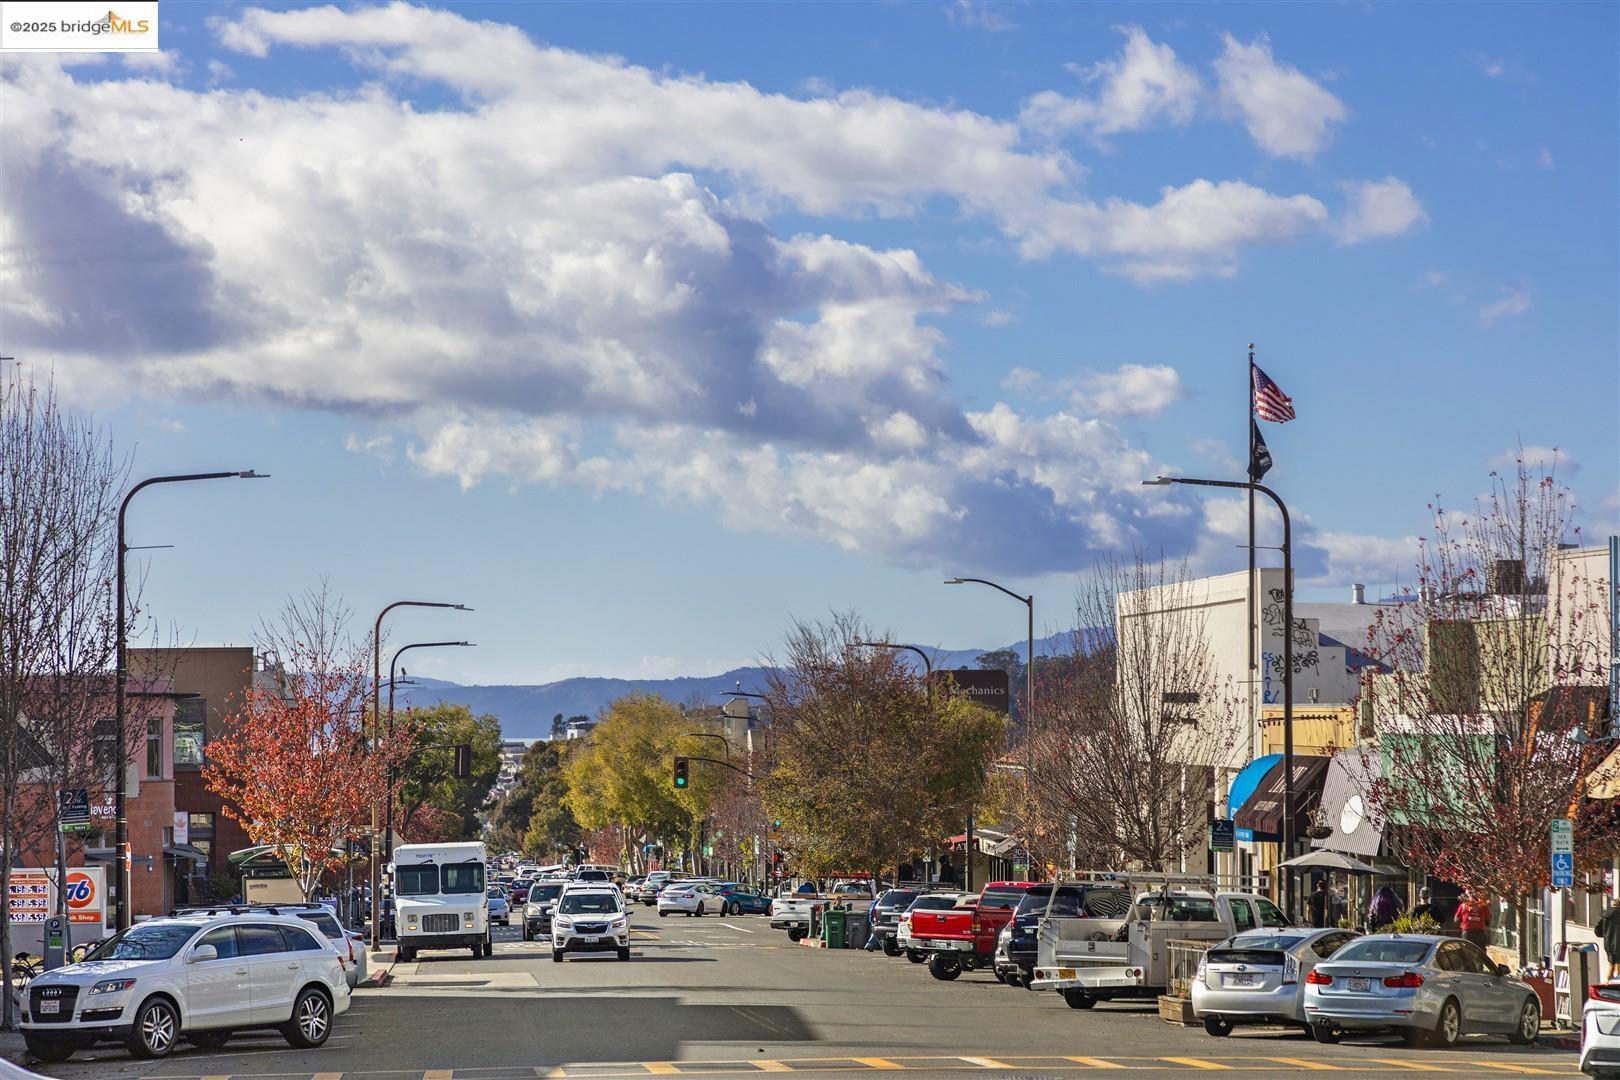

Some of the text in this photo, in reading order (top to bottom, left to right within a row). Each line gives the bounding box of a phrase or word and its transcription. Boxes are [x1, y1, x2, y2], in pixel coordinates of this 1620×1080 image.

[949, 684, 1005, 695] Mechanics
[67, 879, 90, 901] 76
[78, 914, 95, 922] Shop
